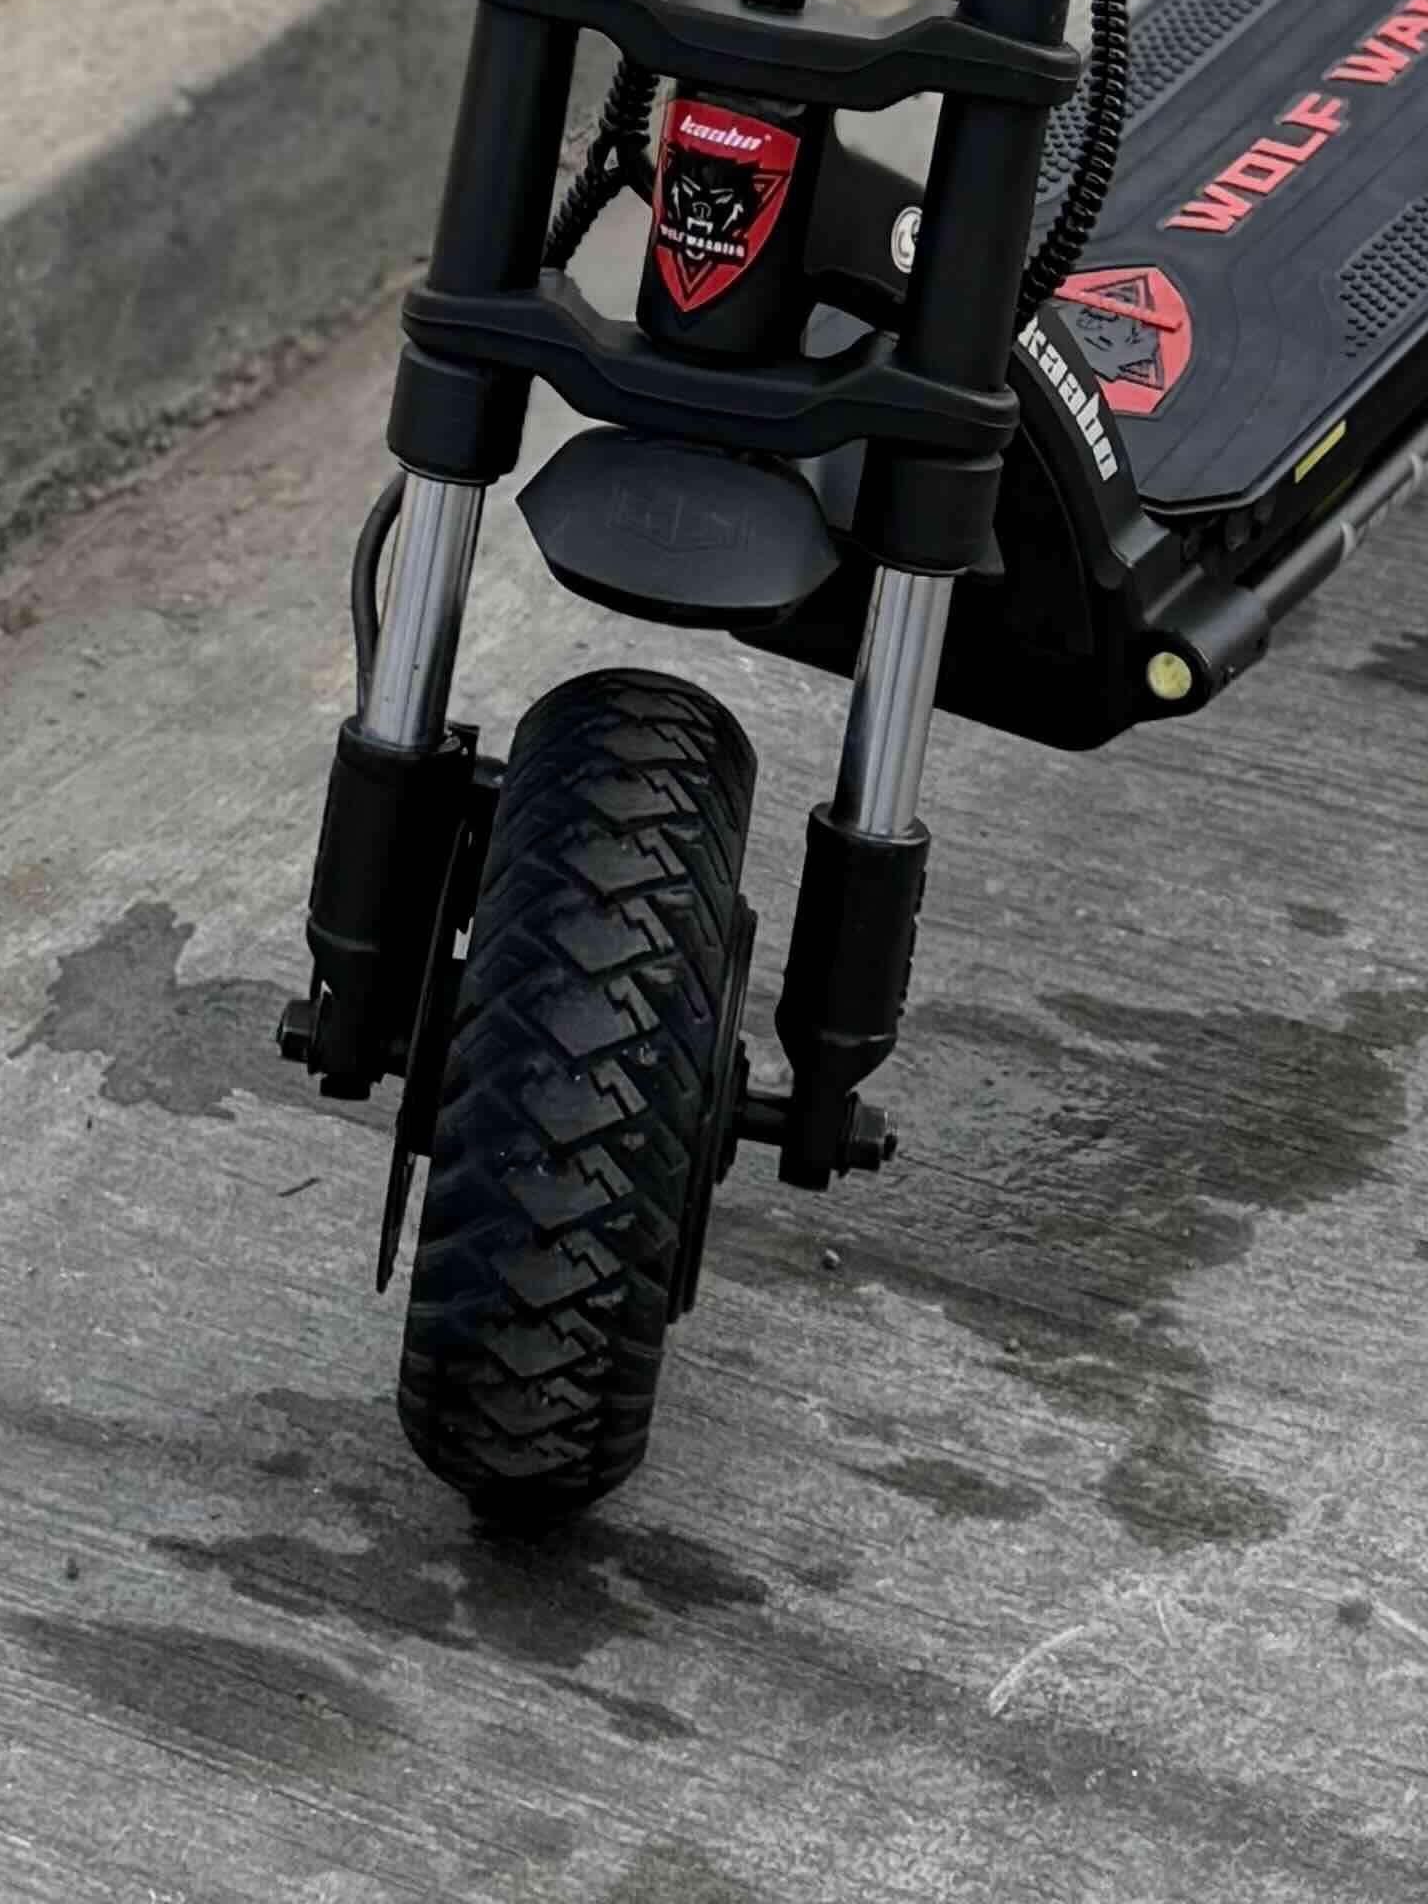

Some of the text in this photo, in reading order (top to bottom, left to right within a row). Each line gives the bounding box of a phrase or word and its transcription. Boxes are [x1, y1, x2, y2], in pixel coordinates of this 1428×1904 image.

[679, 115, 763, 151] kaabo
[1162, 88, 1350, 236] WOLF
[1017, 314, 1120, 483] kaabo
